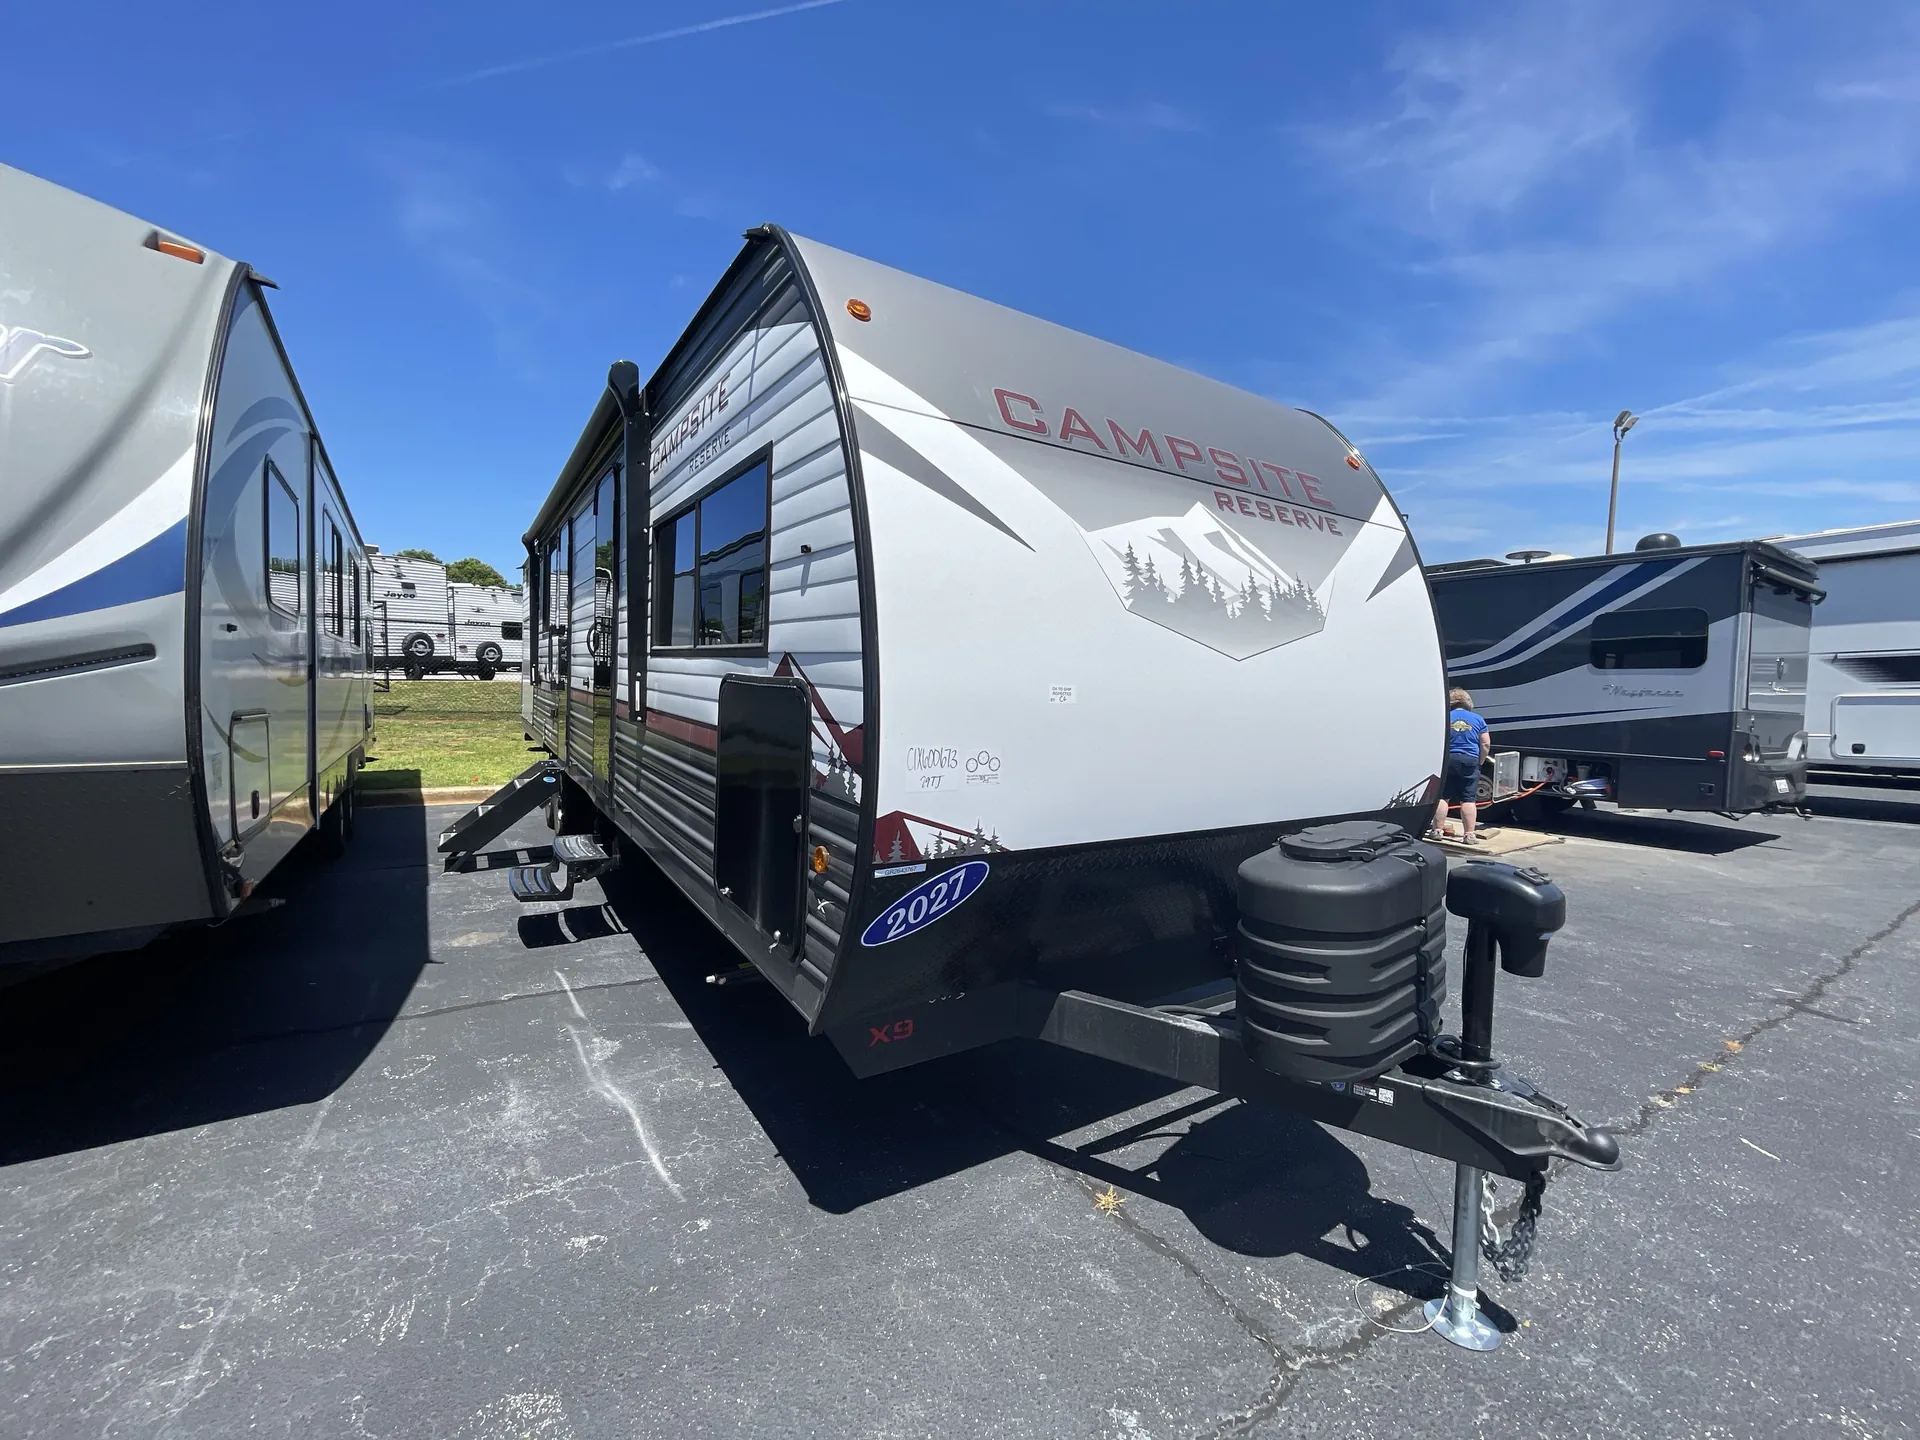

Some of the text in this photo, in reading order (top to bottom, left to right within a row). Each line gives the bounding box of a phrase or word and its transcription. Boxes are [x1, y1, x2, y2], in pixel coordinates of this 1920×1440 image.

[652, 372, 732, 475] CAMPSITE
[688, 426, 731, 474] RESERVE
[992, 386, 1335, 509] CAMPSITE
[1213, 490, 1344, 537] RESERVE
[383, 590, 416, 599] Jayco
[464, 619, 491, 627] Jayco
[887, 868, 967, 939] 2027
[868, 1019, 914, 1048] X9
